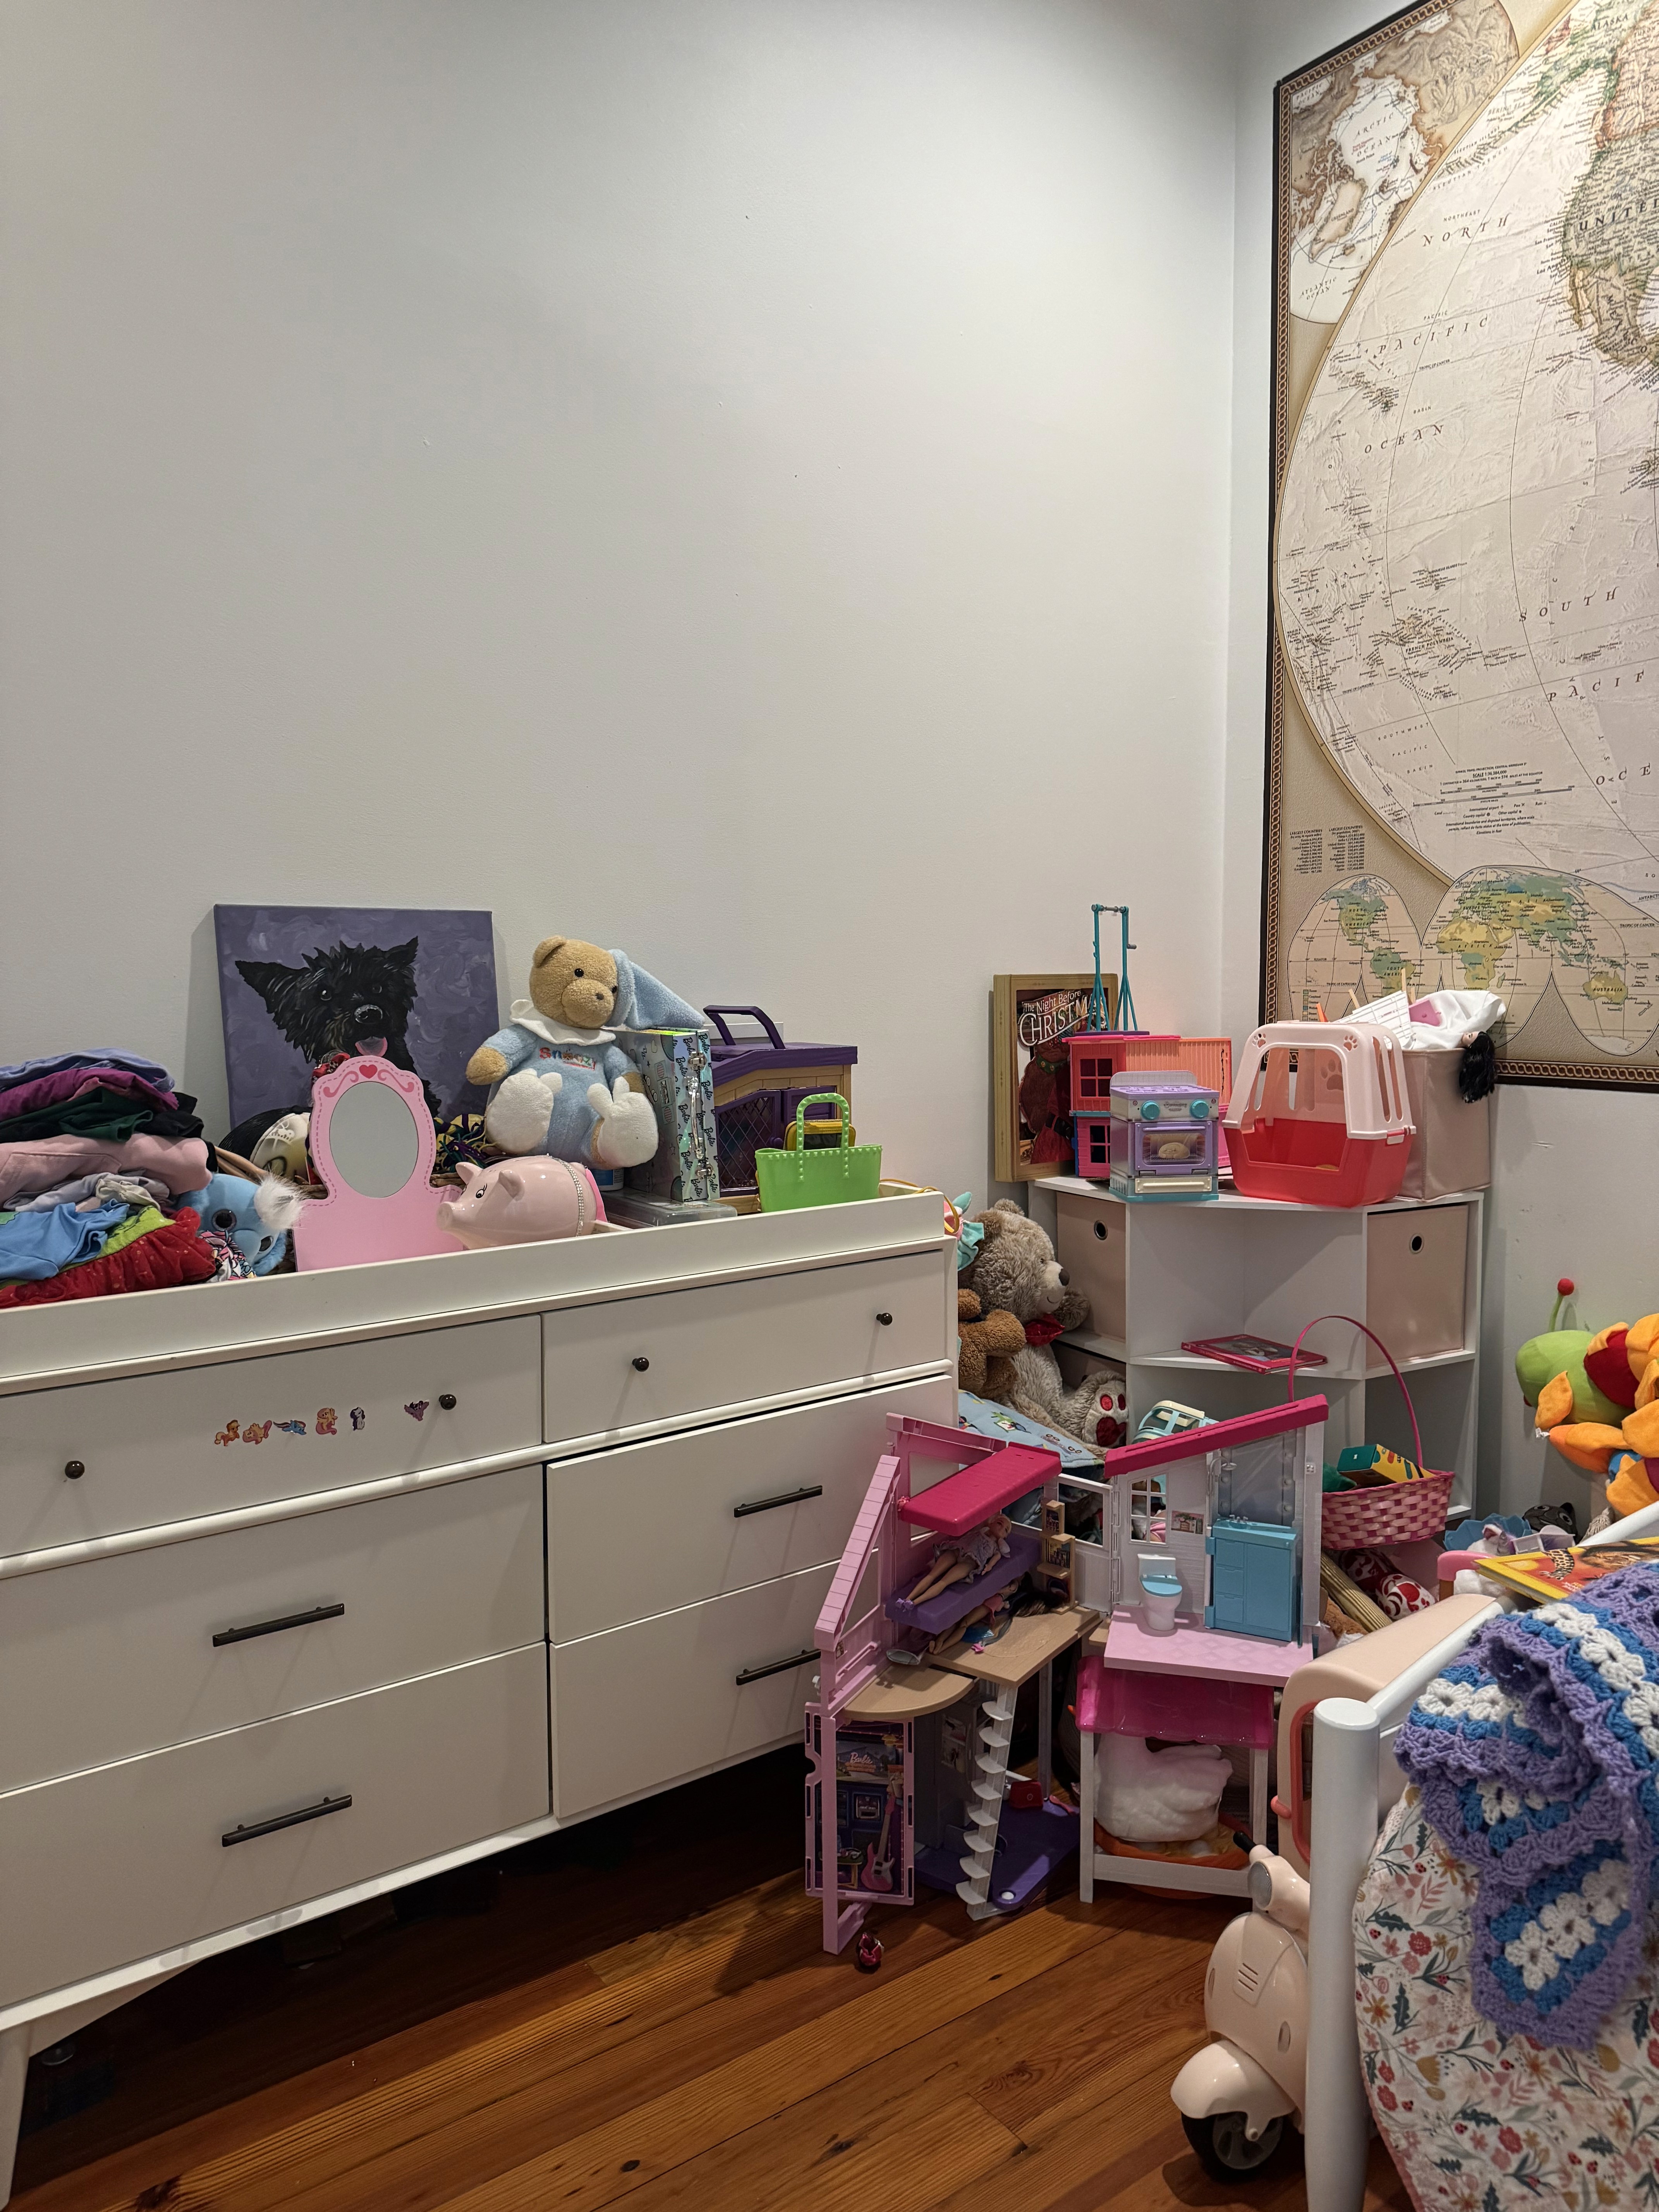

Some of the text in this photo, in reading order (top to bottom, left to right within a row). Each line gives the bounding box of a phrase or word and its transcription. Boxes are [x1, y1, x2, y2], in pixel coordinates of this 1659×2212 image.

[1357, 112, 1394, 136] ARCTIC
[1357, 136, 1391, 157] OCEAN
[1444, 209, 1481, 222] NORTHEAST
[1423, 212, 1512, 247] NORTH
[1378, 314, 1488, 354] PACIFIC
[1413, 406, 1432, 414] BASIN
[1365, 424, 1444, 454] OCEAN
[1519, 586, 1620, 622] SOUTH
[1406, 644, 1425, 653] FRENCH
[1407, 764, 1433, 774] BASIN
[1024, 990, 1081, 1015] The Night Before
[1020, 994, 1107, 1046] CHRISTM
[683, 1037, 693, 1056] Barbi
[699, 1033, 710, 1054] Barbie
[676, 1056, 688, 1076] Barbie
[701, 1080, 713, 1100] Barbie
[678, 1104, 690, 1123] Barbie
[704, 1127, 716, 1147] Barbie
[681, 1151, 693, 1170] Barbie
[691, 1179, 703, 1197] Barbie
